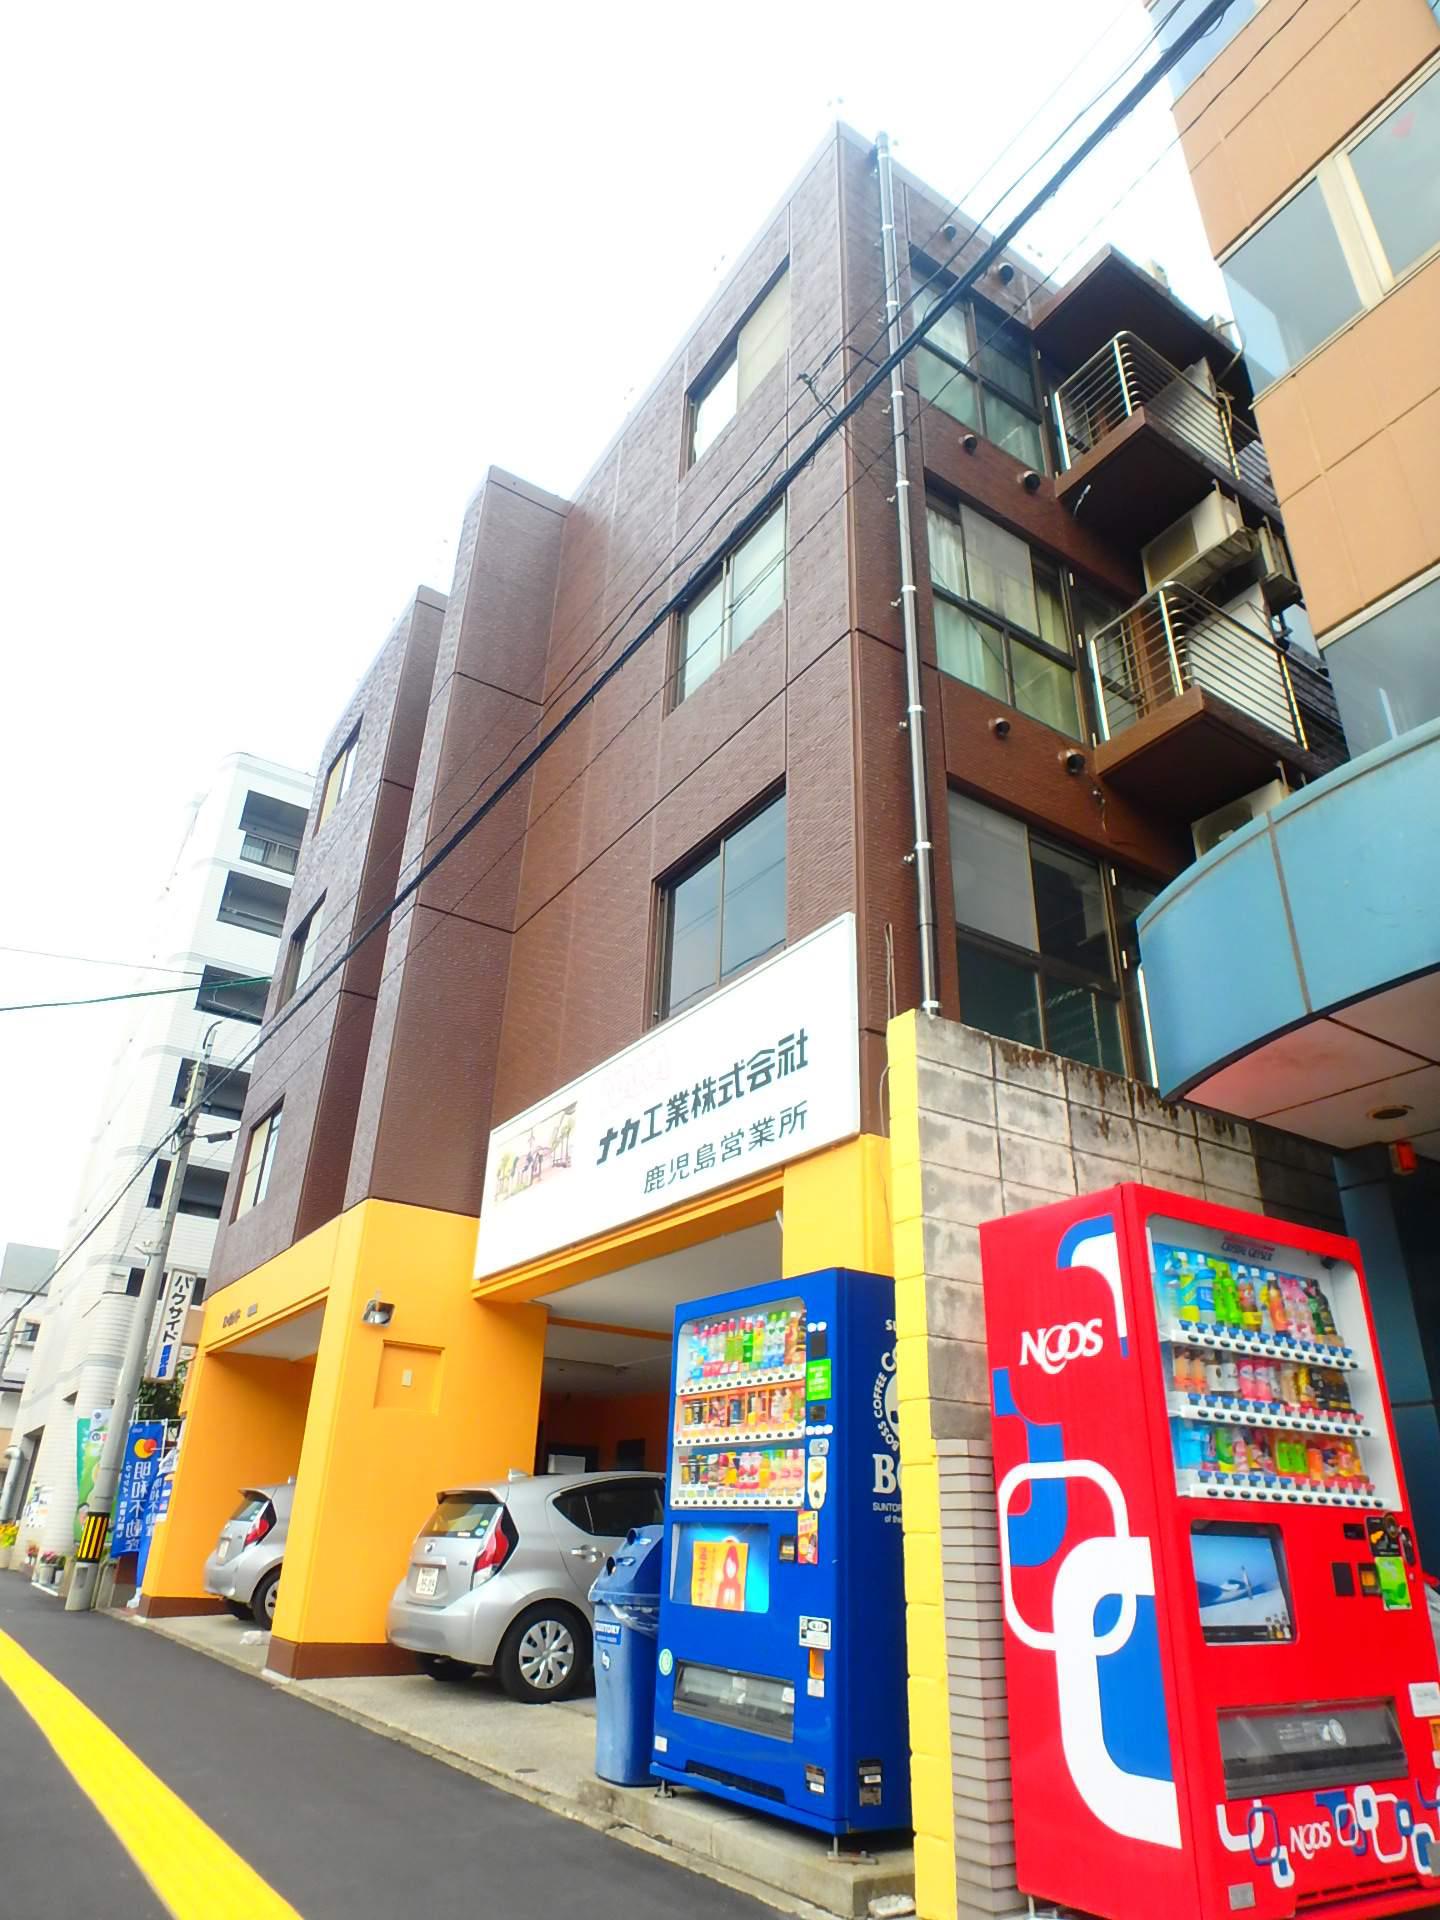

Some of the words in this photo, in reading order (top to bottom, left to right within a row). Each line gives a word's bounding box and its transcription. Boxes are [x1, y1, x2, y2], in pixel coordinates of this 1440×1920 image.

[596, 1028, 808, 1165] ナカ工業株式会社
[643, 1100, 808, 1194] 鹿児島営業所
[162, 1275, 195, 1343] パークサイド
[873, 1371, 888, 1418] COFFEE
